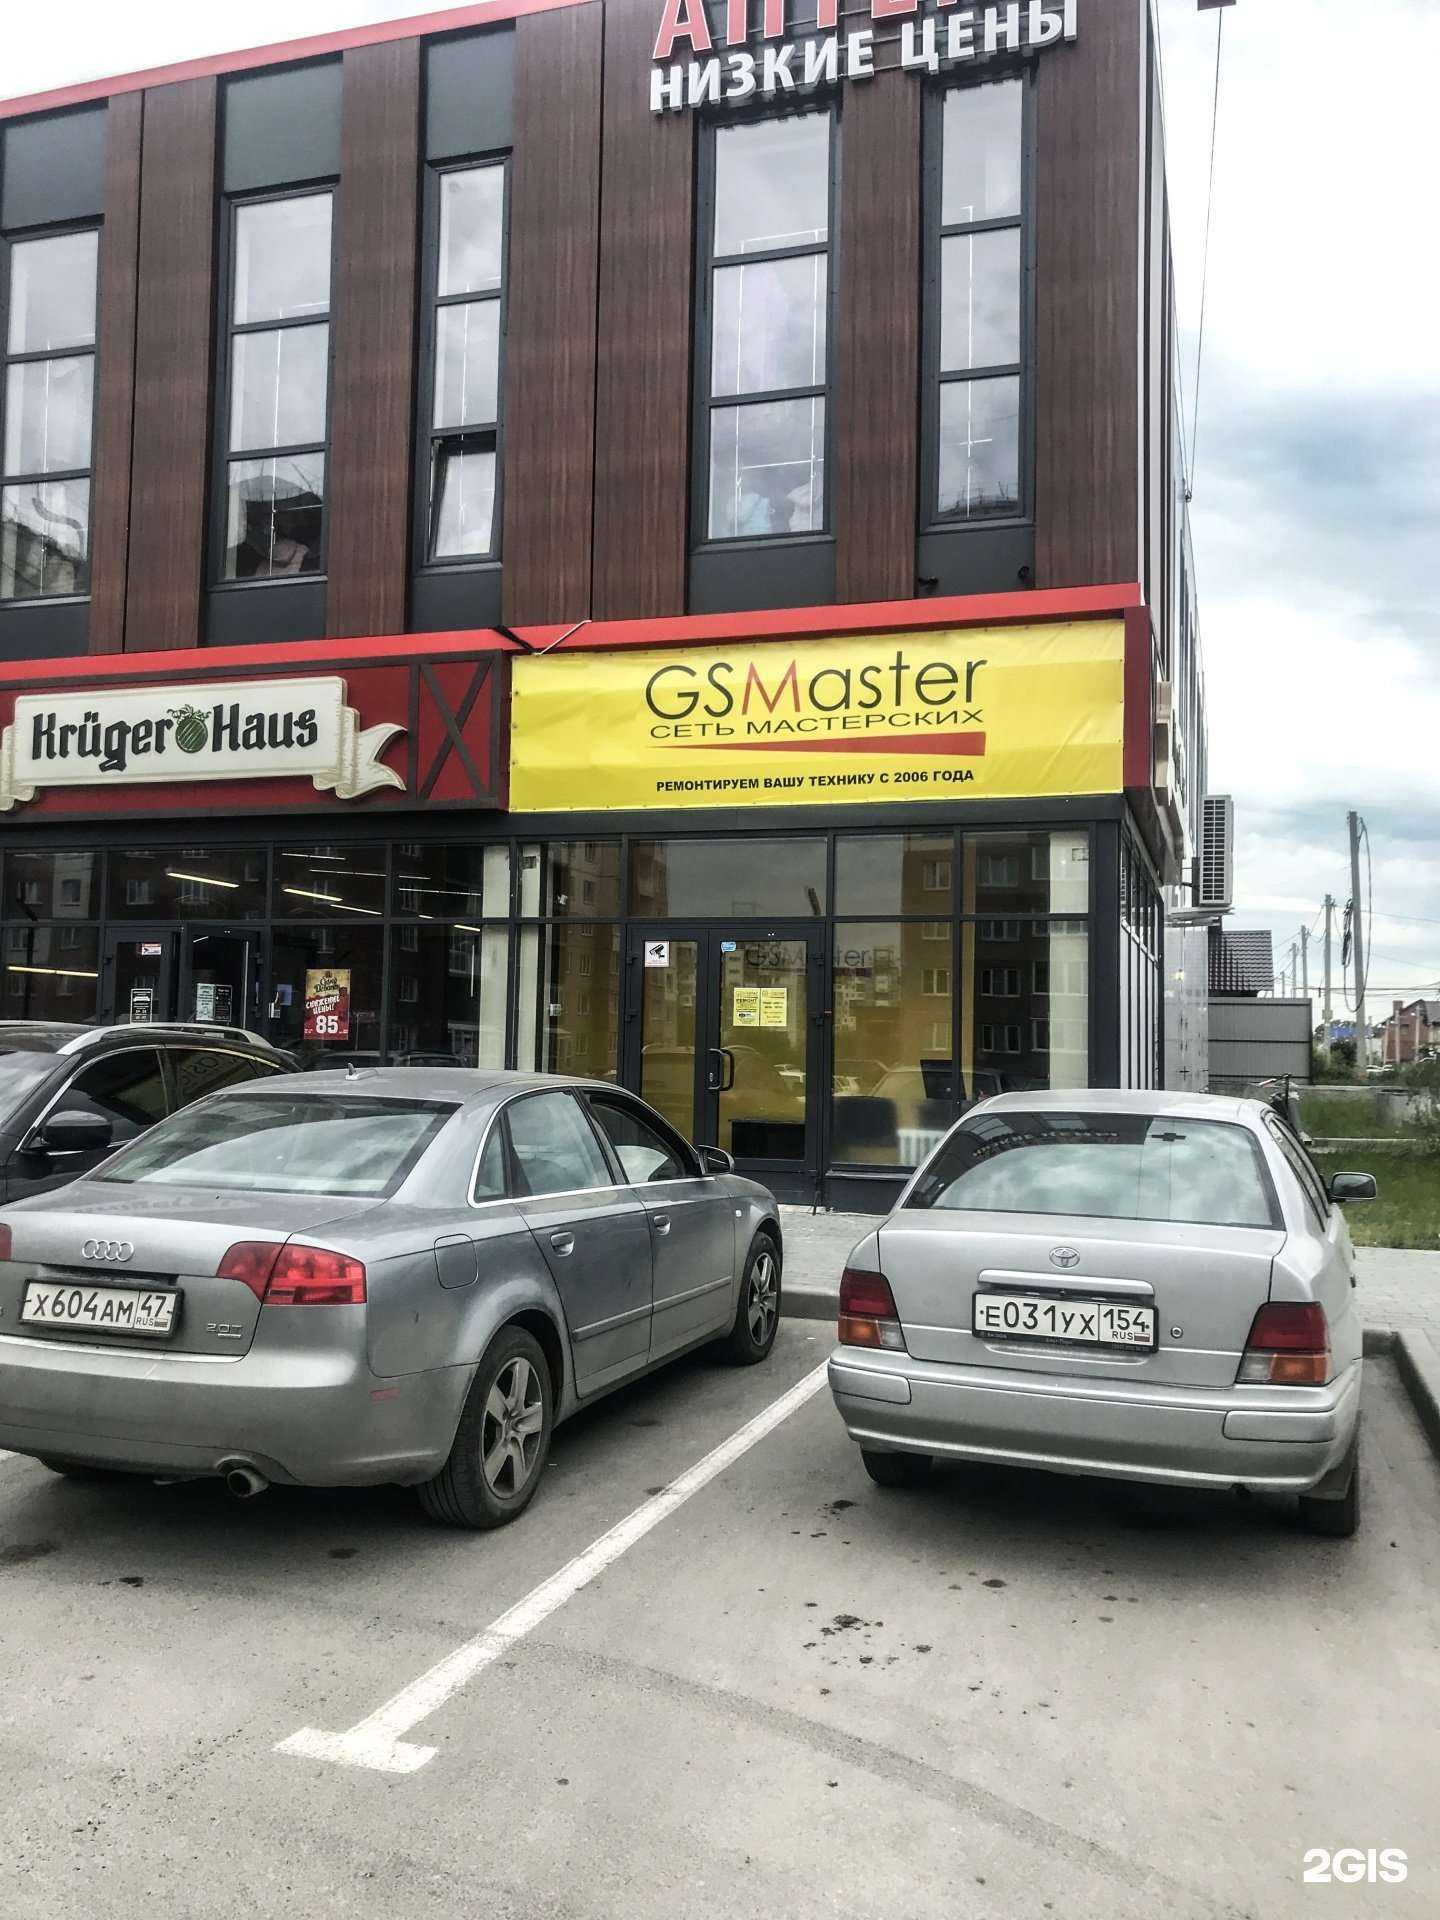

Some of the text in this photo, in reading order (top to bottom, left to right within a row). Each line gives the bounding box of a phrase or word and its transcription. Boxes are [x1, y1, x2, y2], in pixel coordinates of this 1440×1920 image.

[649, 29, 875, 112] НИЗКИЕ
[901, 0, 1078, 72] ЦЕНЫ
[645, 650, 988, 720] GSMaster
[650, 709, 984, 739] СЕТЬ МАСТЕРСКИХ
[32, 703, 318, 772] Krüger Haus
[656, 769, 974, 792] РЕМОНТИРУЕМ ВАШУ ТЕХНИКУ С 2006 ГОДА
[315, 1015, 338, 1034] 85
[140, 1292, 167, 1317] 47
[135, 1317, 154, 1328] RUS
[1103, 1309, 1146, 1333] 154
[1112, 1331, 1133, 1341] RUS
